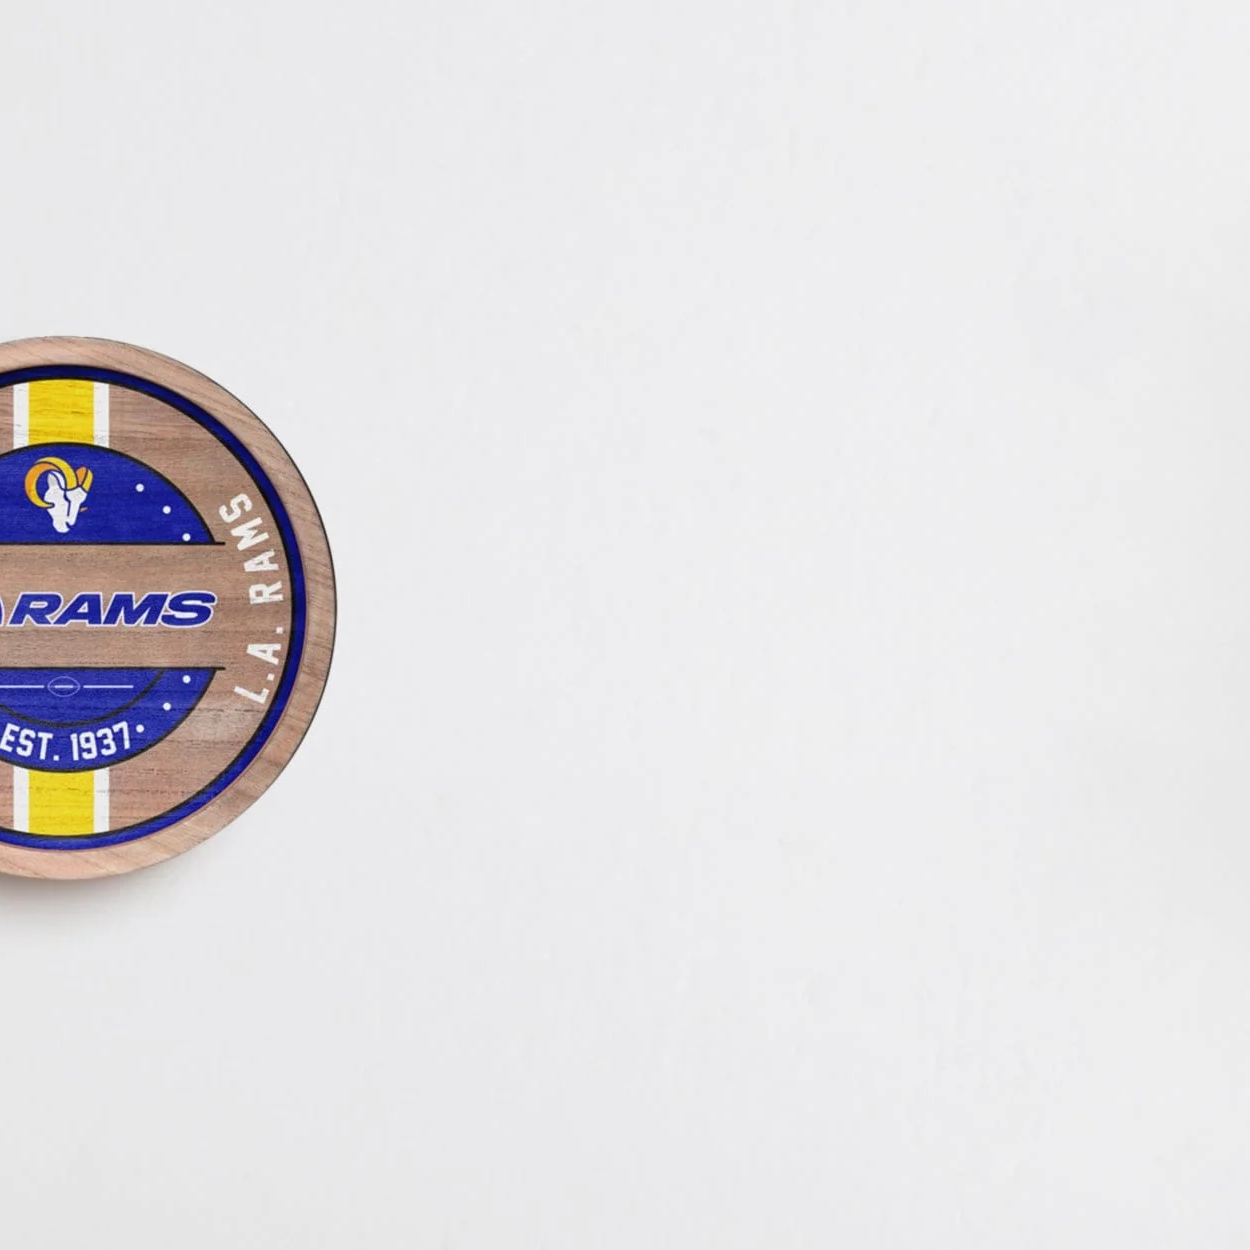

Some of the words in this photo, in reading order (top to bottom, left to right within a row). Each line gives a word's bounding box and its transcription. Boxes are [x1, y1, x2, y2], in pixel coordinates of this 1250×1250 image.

[219, 493, 283, 604] RAMS
[234, 626, 283, 704] L.A.
[70, 720, 131, 761] 1937
